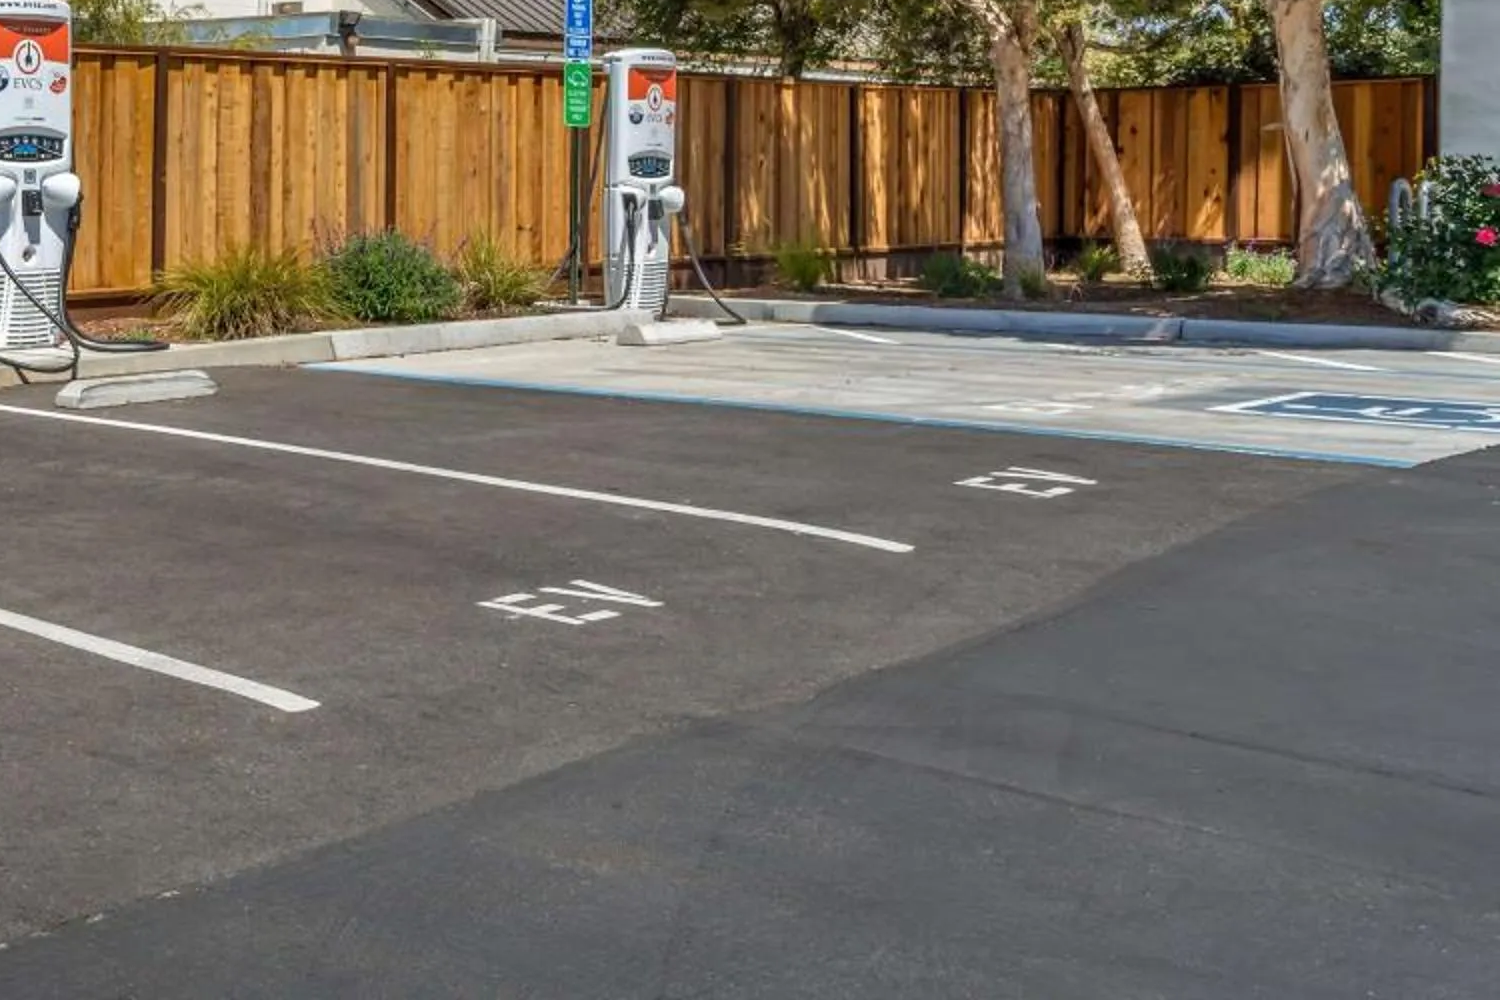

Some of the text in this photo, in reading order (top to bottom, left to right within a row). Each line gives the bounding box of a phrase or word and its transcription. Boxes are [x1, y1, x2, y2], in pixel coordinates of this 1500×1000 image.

[13, 77, 43, 90] EVCS
[952, 466, 1099, 499] EV
[475, 578, 666, 626] EV
